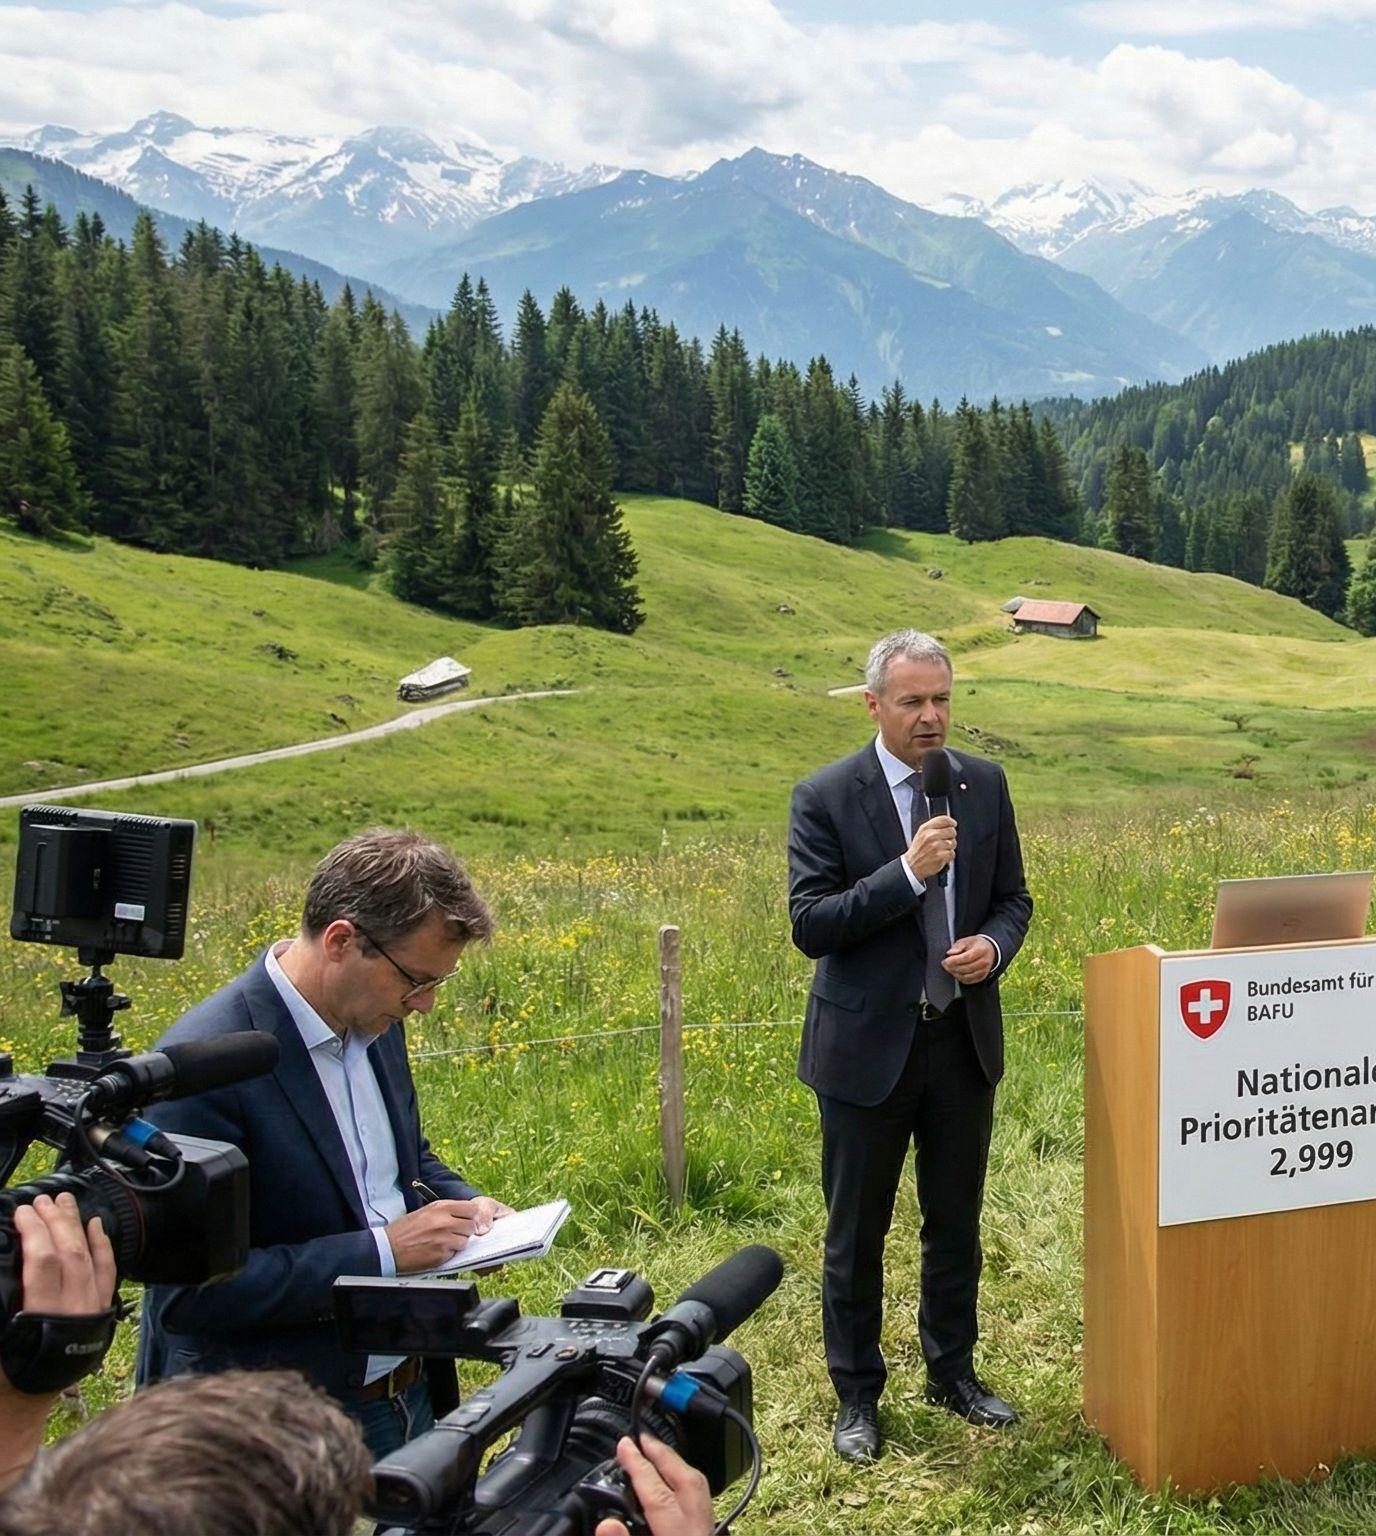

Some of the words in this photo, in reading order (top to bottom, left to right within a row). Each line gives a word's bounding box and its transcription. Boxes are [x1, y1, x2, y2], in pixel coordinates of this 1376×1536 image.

[1247, 975, 1345, 998] Bundesamt
[1348, 970, 1375, 989] für
[1247, 1002, 1294, 1022] BAFU
[1270, 1140, 1354, 1178] 2,999
